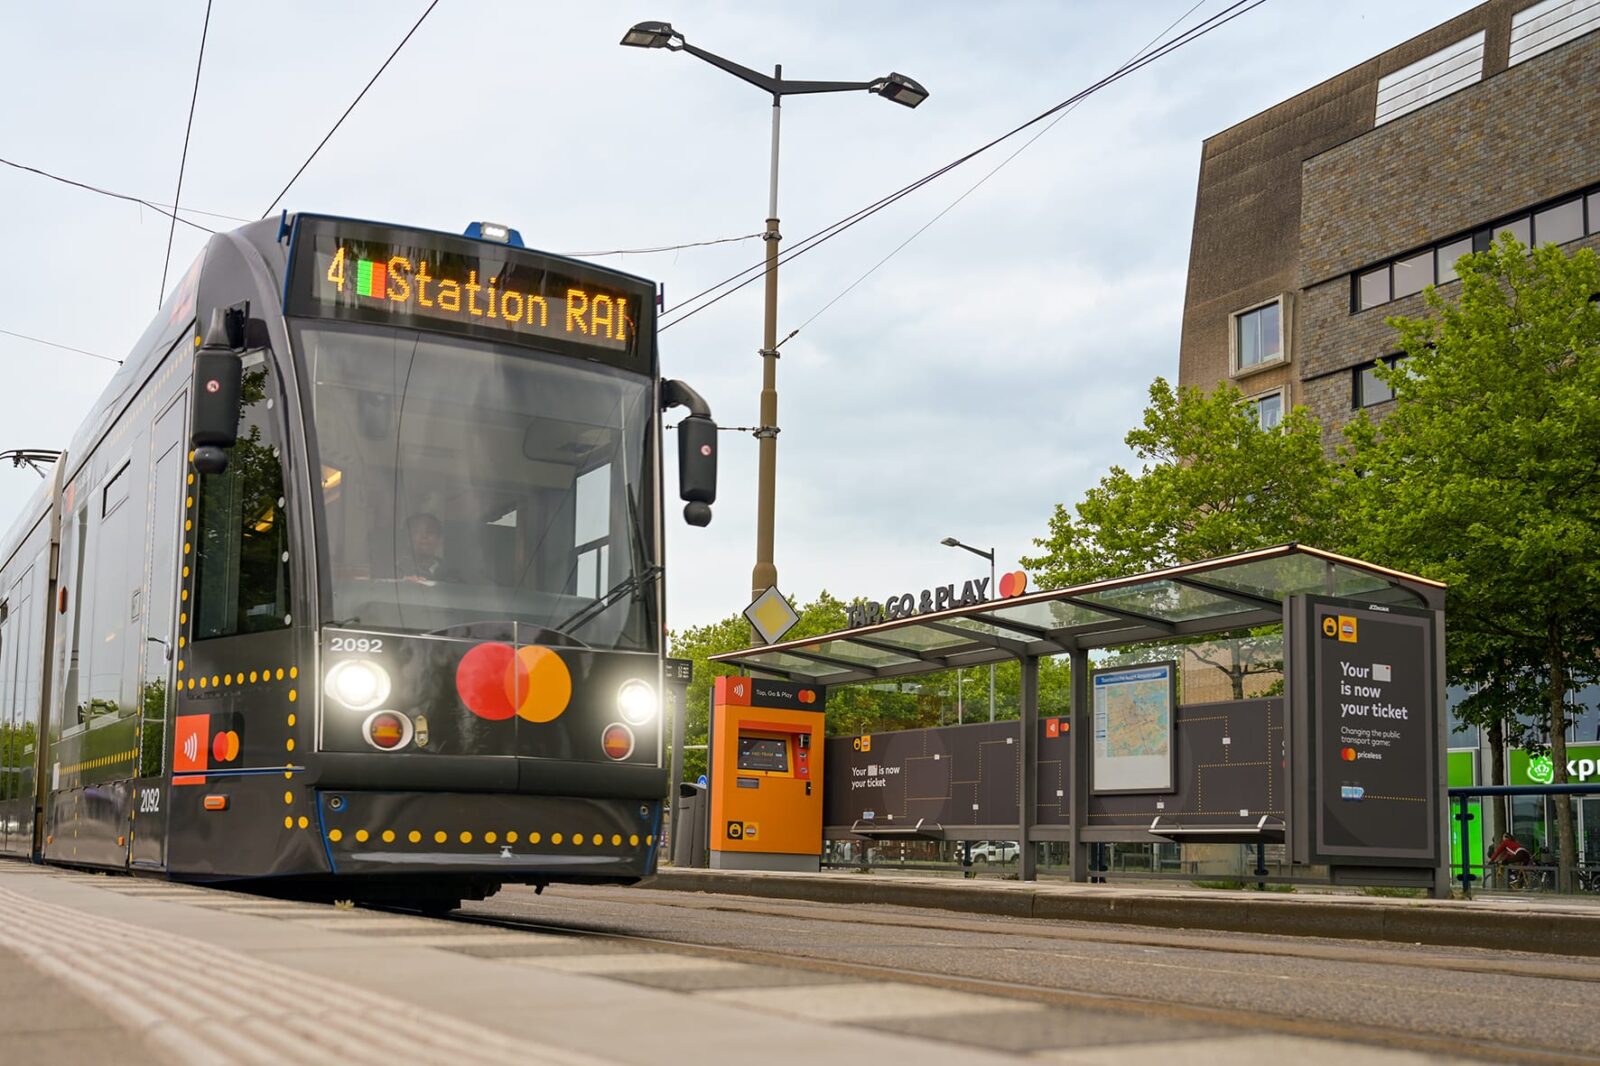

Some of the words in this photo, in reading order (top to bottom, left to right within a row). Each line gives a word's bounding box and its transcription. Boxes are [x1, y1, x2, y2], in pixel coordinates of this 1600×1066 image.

[327, 247, 346, 292] 4
[386, 256, 549, 328] Station
[566, 288, 628, 341] RAI
[884, 593, 915, 620] GO
[918, 589, 934, 614] &
[934, 577, 990, 611] PLAY
[330, 637, 383, 653] 2092
[1340, 661, 1370, 678] Your
[781, 691, 793, 699] Play
[1340, 680, 1352, 696] is
[1354, 685, 1381, 698] now
[1340, 703, 1369, 718] your
[1371, 702, 1408, 720] ticket
[1340, 726, 1371, 738] Changing
[1371, 729, 1381, 737] the
[1382, 730, 1401, 739] public
[1341, 736, 1371, 746] transport
[1357, 751, 1382, 760] priceless
[852, 767, 867, 776] Your
[879, 765, 885, 775] is
[885, 766, 900, 775] now
[1566, 759, 1600, 782] kp
[851, 780, 866, 790] your
[867, 778, 886, 788] ticket
[140, 787, 160, 813] 2092
